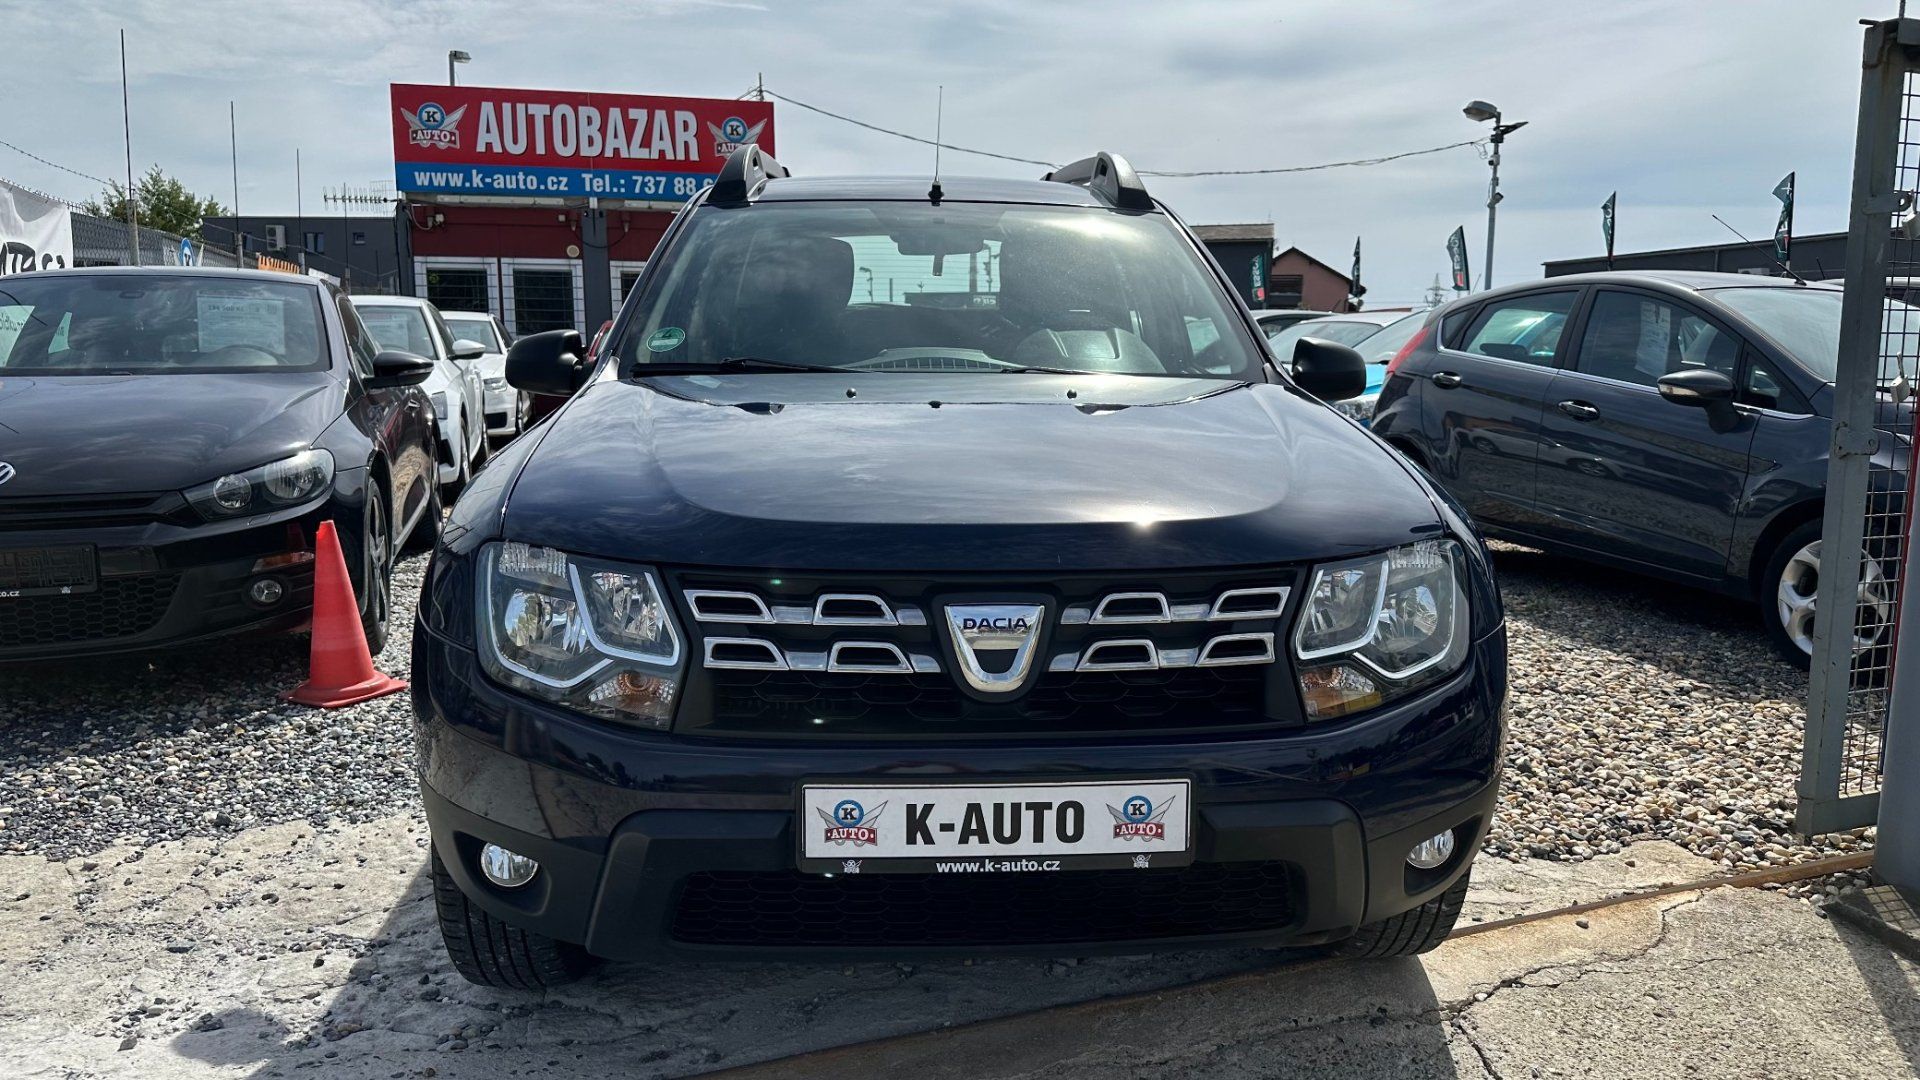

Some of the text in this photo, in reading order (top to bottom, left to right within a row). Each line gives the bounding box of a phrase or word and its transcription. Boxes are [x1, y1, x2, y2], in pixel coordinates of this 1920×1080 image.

[424, 110, 439, 123] K
[416, 129, 451, 142] AUTO
[476, 101, 700, 161] AUTOBAZAR
[728, 124, 742, 136] K
[414, 169, 568, 191] www.k-auto.cz
[581, 173, 626, 193] Tel.:
[632, 175, 667, 195] 737
[673, 176, 697, 196] 88
[963, 618, 1028, 629] DACIA
[841, 807, 857, 820] K
[1130, 803, 1146, 816] K
[905, 800, 1085, 845] K-AUTO
[1119, 823, 1157, 835] AUTO
[831, 827, 869, 840] AUTO
[936, 859, 1061, 873] www.k-auto.cz
